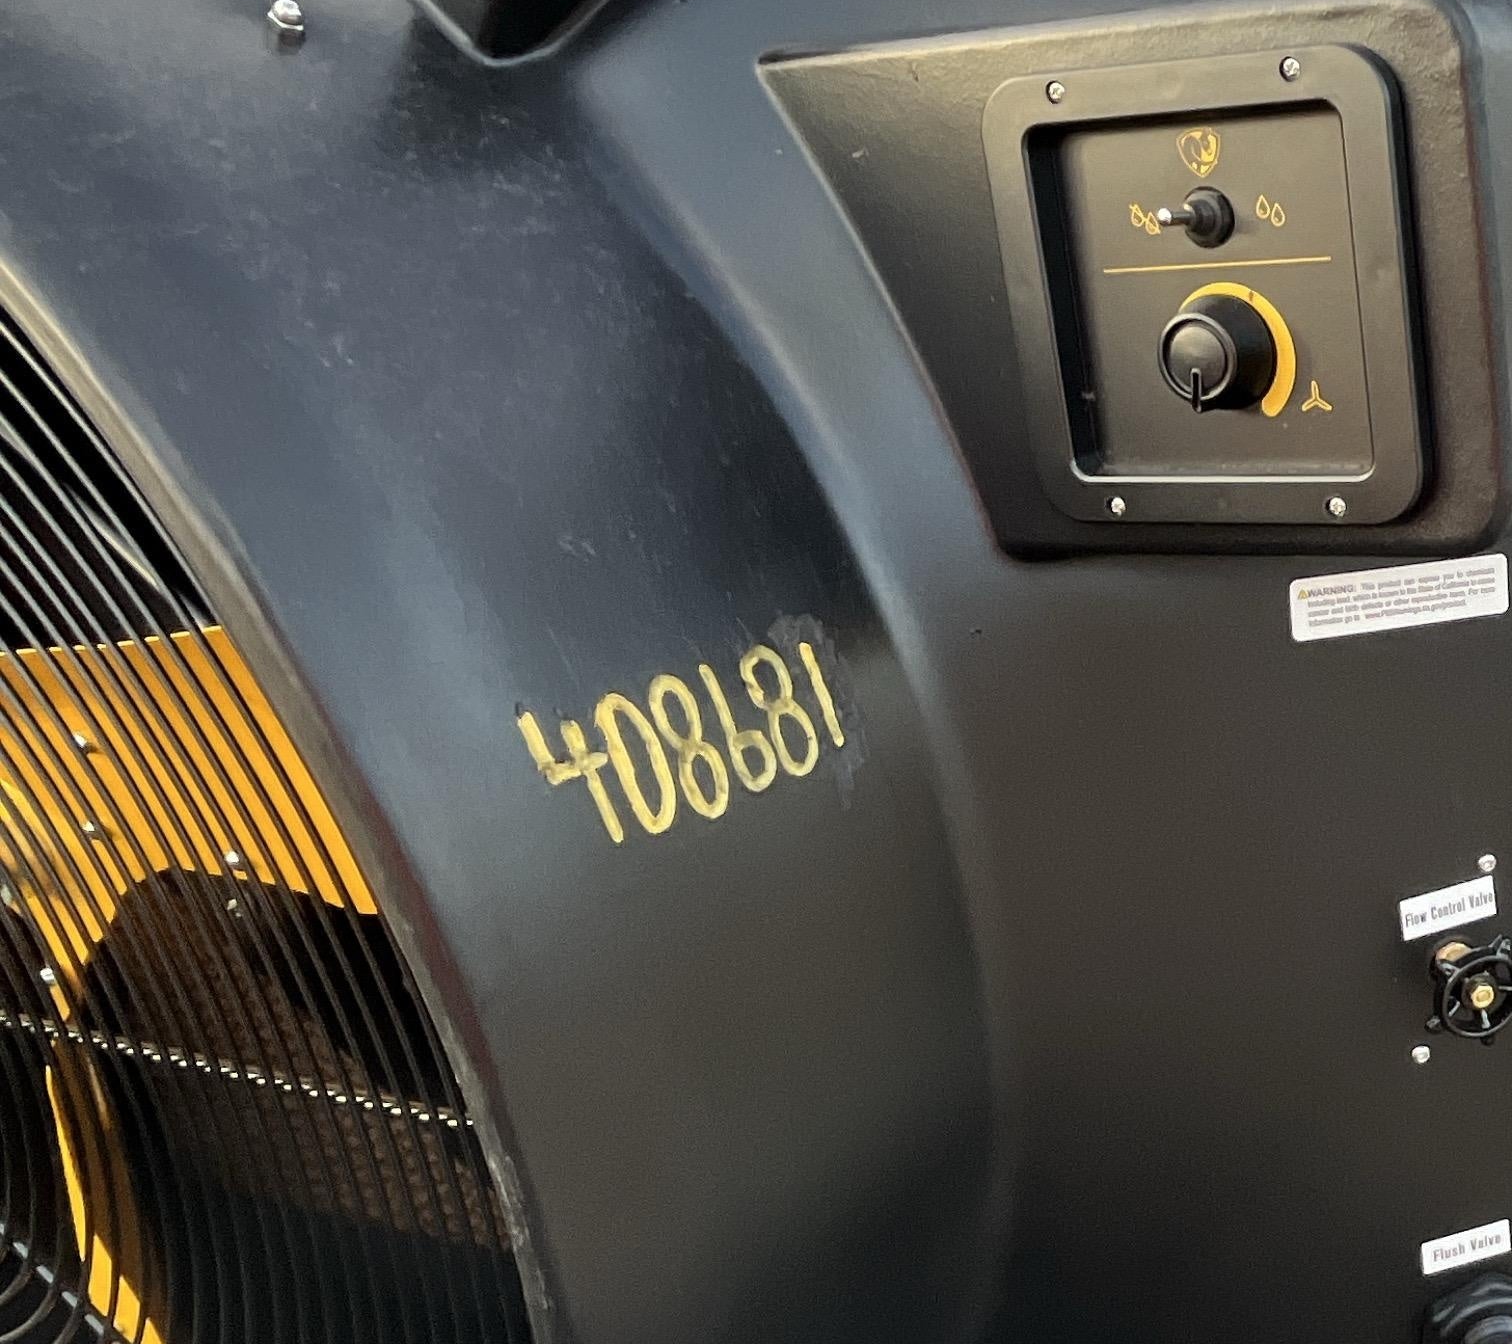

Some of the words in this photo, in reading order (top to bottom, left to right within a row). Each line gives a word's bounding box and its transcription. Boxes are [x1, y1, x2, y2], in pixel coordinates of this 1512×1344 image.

[517, 642, 845, 843] 408681
[1404, 911, 1428, 928] Flow
[1430, 896, 1466, 921] Control
[1468, 891, 1494, 906] Valve
[1432, 1243, 1466, 1263] Flush
[1470, 1234, 1501, 1251] Valve
